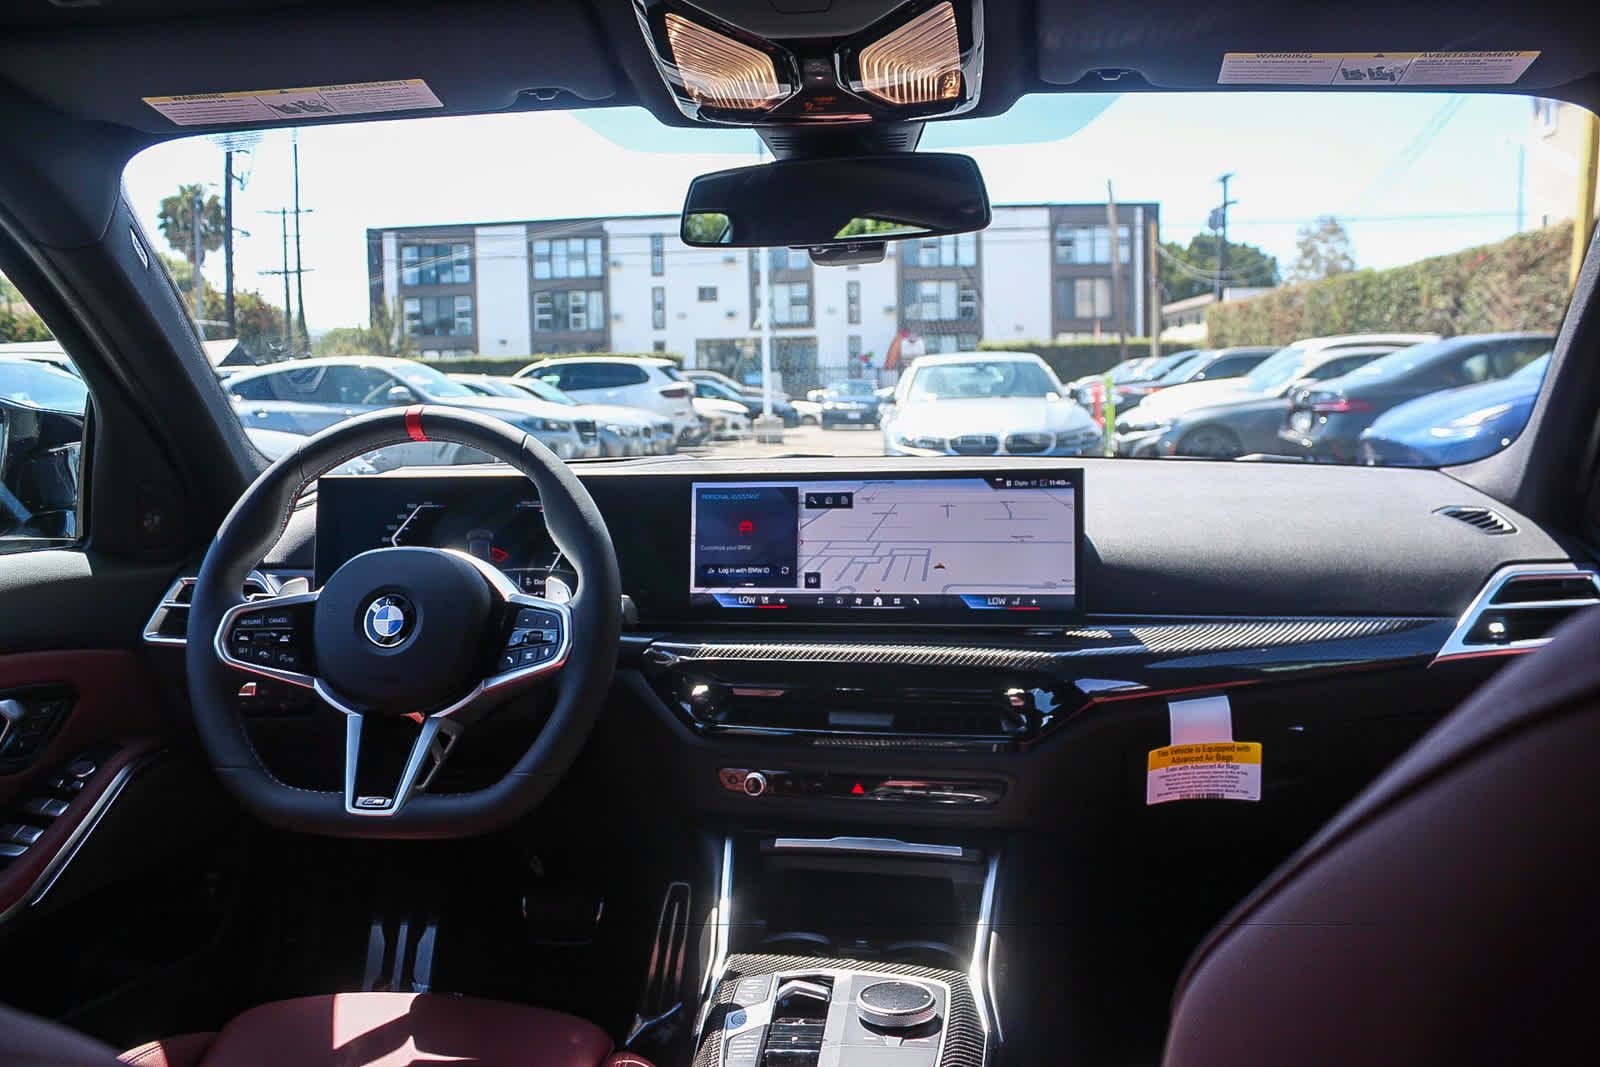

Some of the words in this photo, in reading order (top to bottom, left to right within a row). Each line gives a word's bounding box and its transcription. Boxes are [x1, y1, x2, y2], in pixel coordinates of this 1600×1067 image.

[718, 567, 729, 575] Log
[738, 595, 756, 604] LOW
[987, 596, 1007, 605] LOW
[1170, 746, 1194, 755] Vehicle
[1202, 744, 1234, 754] Equipped
[1236, 744, 1252, 753] with
[1171, 755, 1203, 764] Advanced
[1205, 753, 1214, 762] Air
[1215, 753, 1234, 763] Bags
[1190, 763, 1216, 771] Advanced
